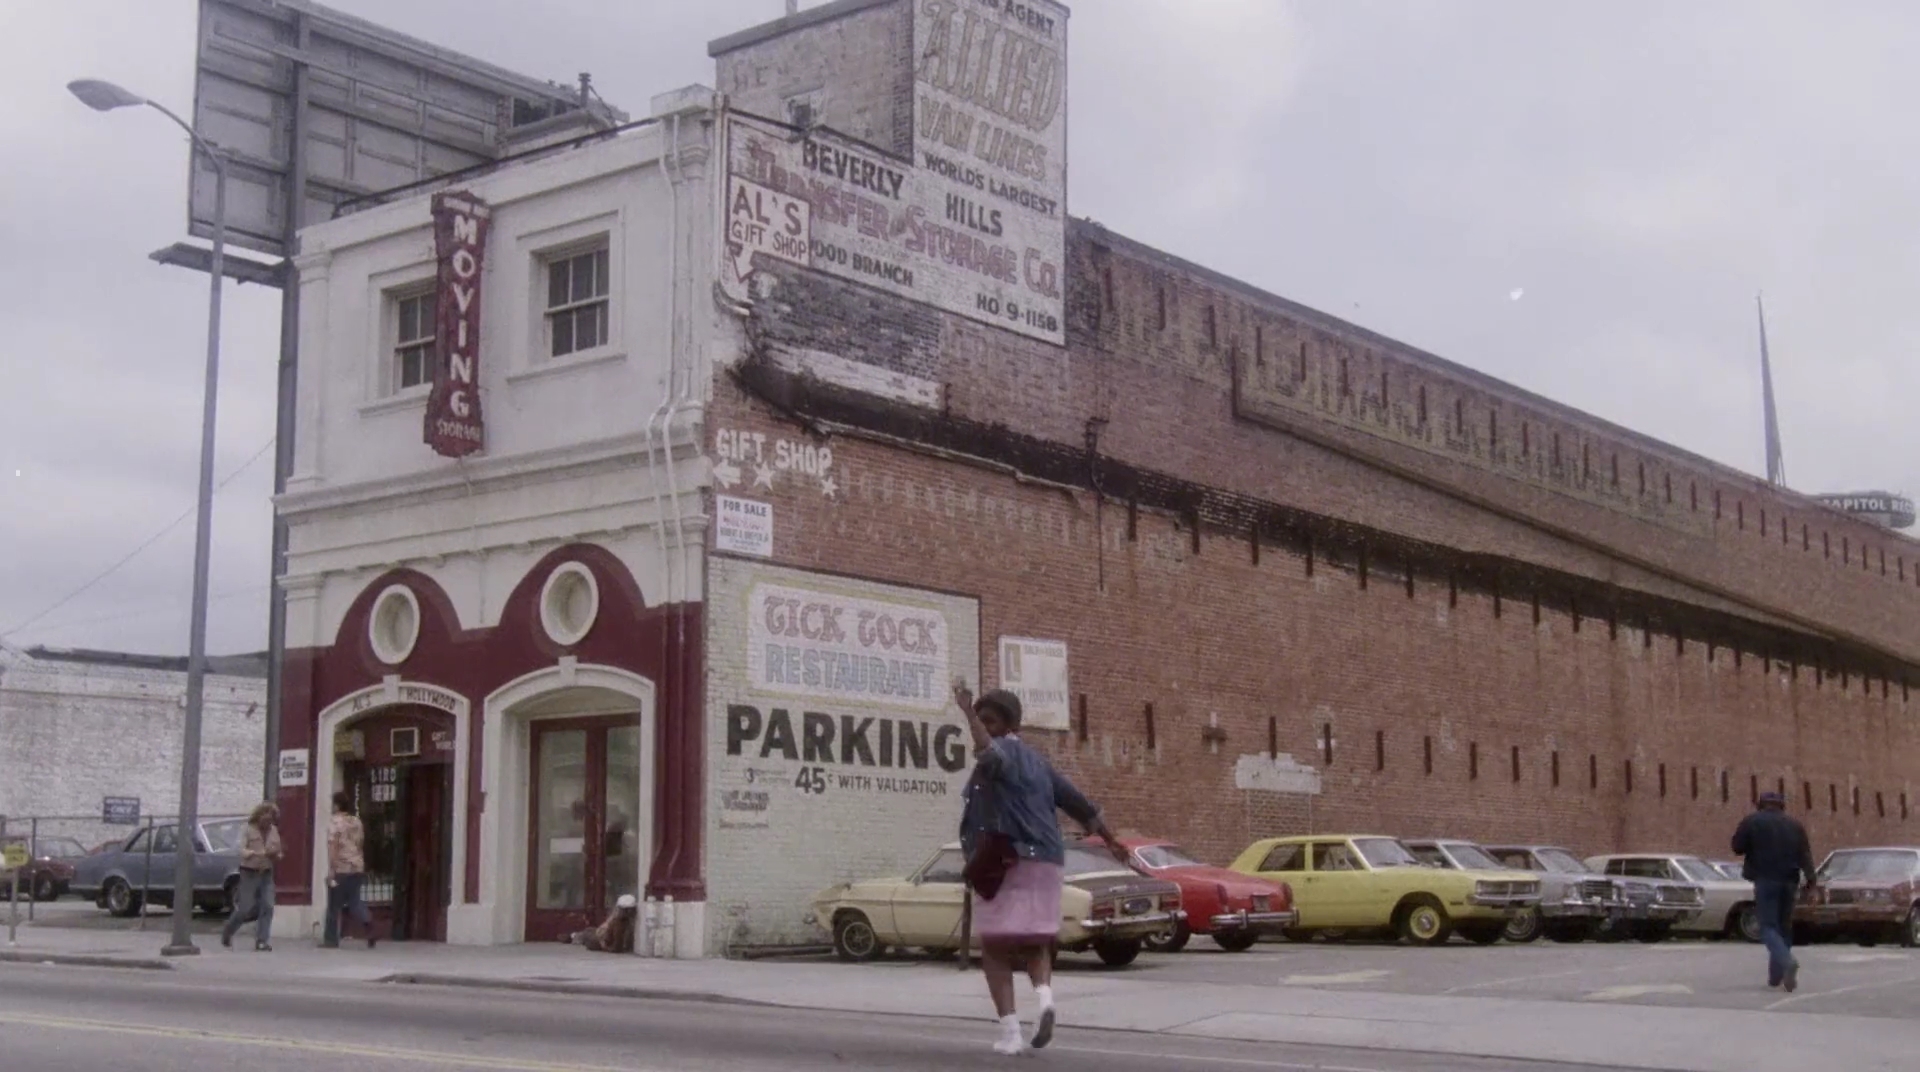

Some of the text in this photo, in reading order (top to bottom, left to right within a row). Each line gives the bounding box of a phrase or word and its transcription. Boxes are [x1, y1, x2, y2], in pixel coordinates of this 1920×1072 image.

[1004, 0, 1055, 37] AGENT
[914, 0, 1062, 132] ALLIED
[919, 95, 1048, 181] VAN LINES
[802, 137, 904, 200] BEVERLY
[732, 185, 802, 236] AL'S
[946, 192, 1003, 237] HILLS
[989, 177, 1057, 215] LARGEST
[731, 219, 807, 261] GIFT SHOP
[853, 252, 914, 288] BRANCH
[450, 213, 478, 418] MOVING
[715, 427, 833, 477] GIFT SHOP
[722, 499, 767, 518] FOR SALE
[763, 595, 938, 656] TICK TOCK
[765, 642, 936, 699] RESTAURANT
[726, 703, 967, 773] PARKING
[838, 775, 871, 791] WITH
[876, 776, 948, 796] VALIDATION
